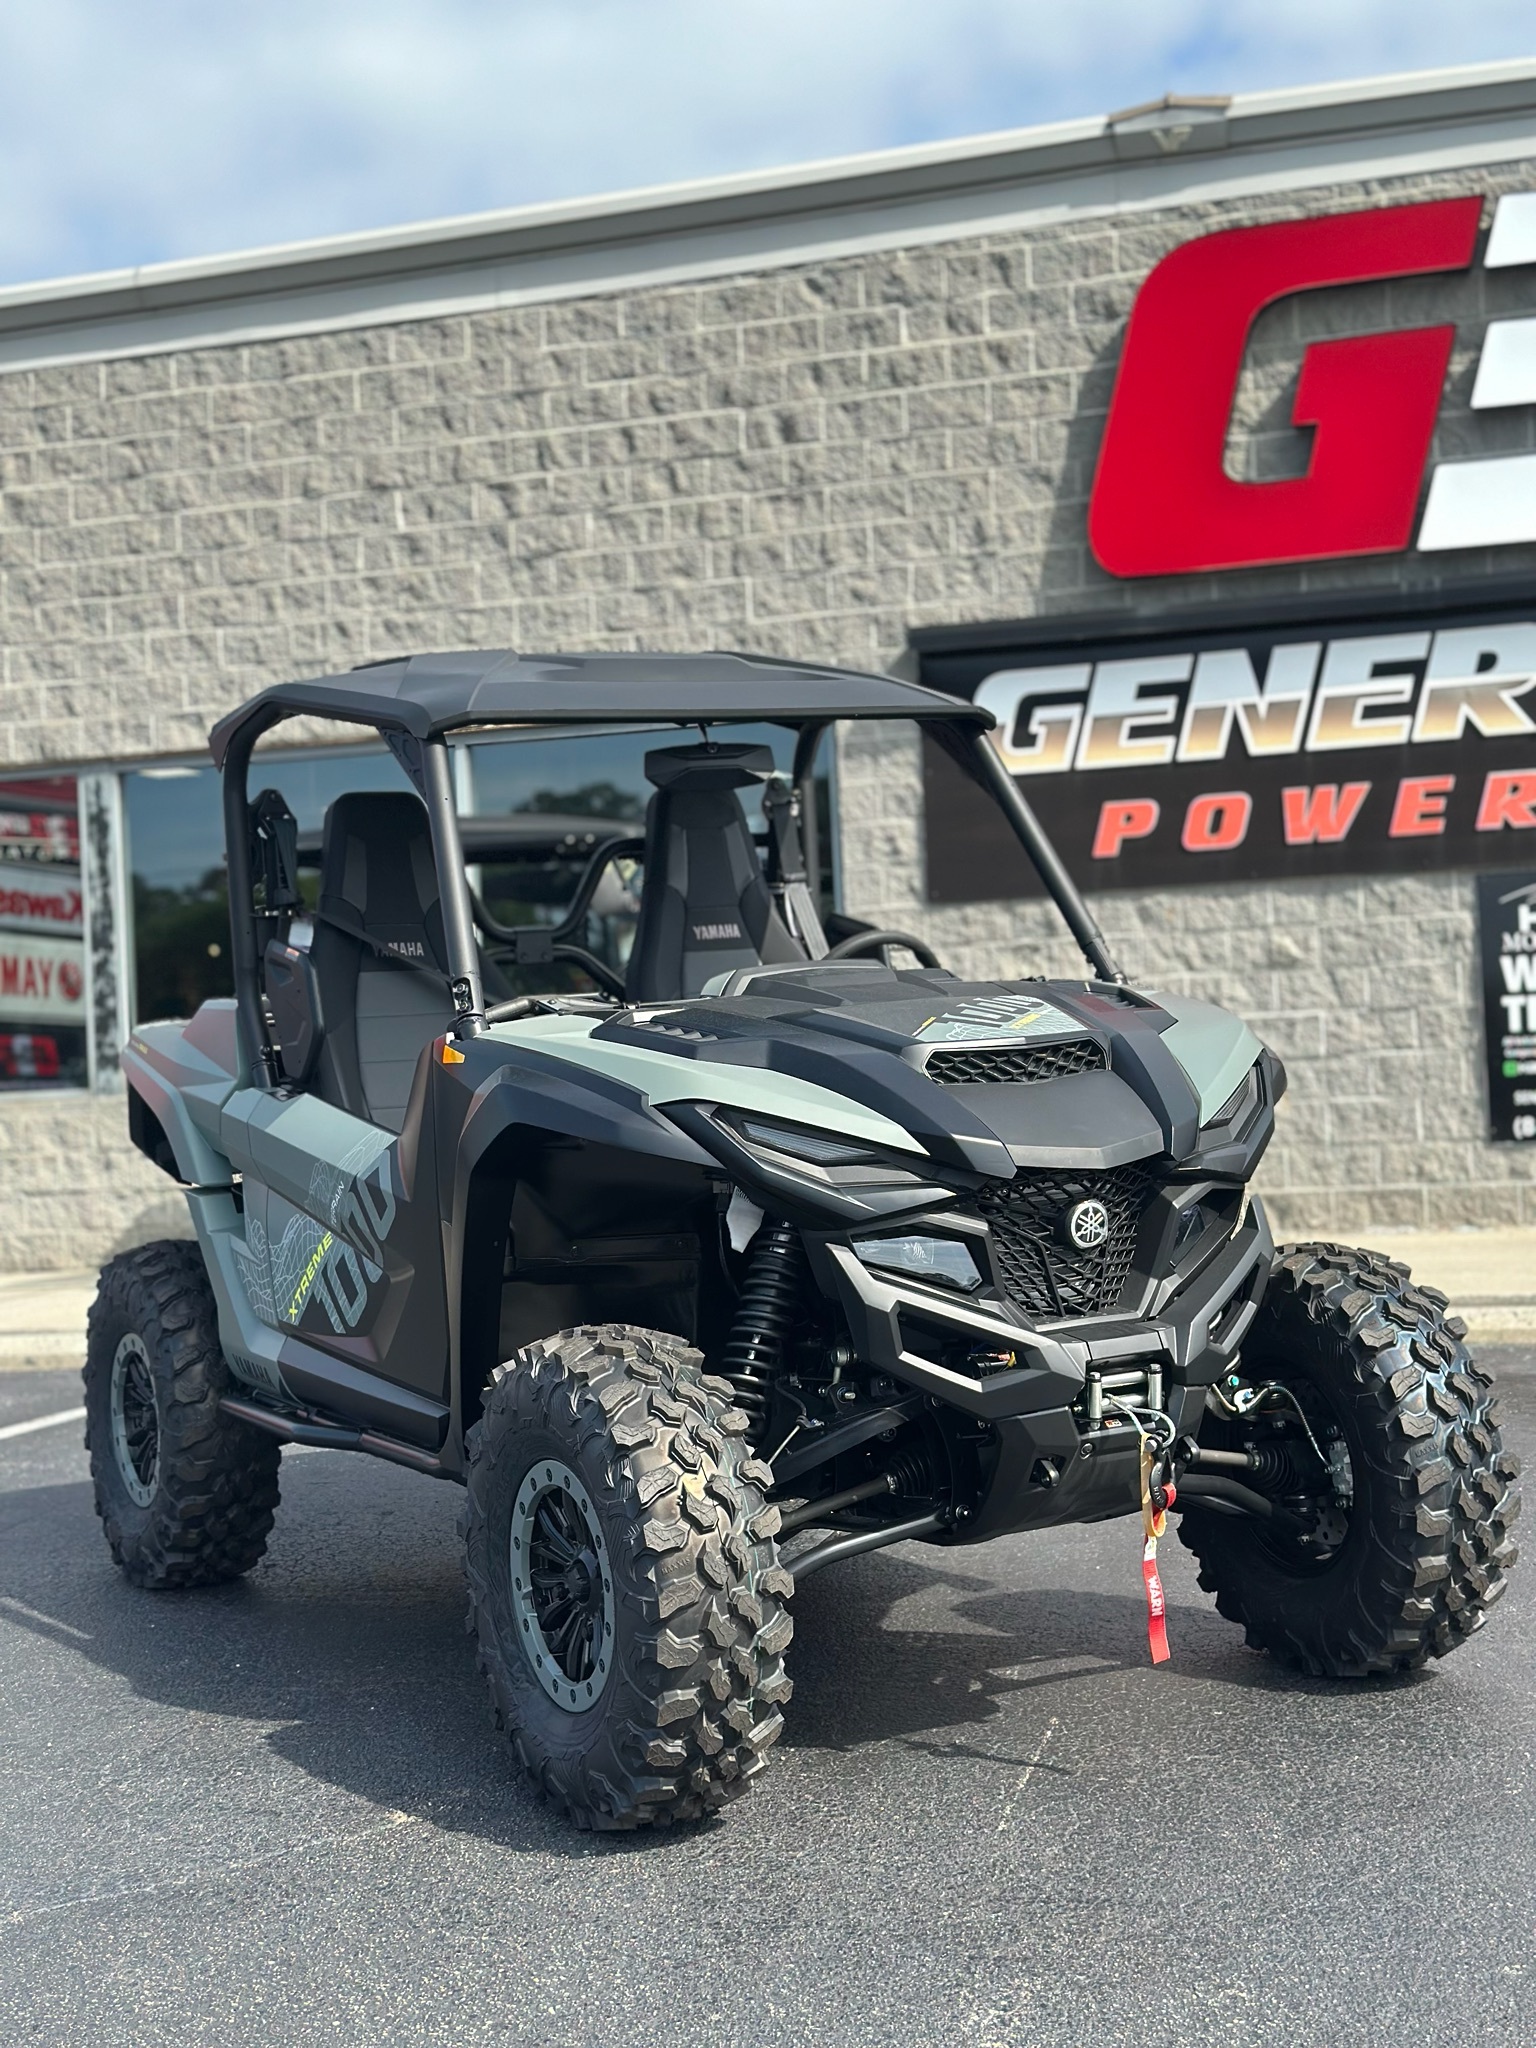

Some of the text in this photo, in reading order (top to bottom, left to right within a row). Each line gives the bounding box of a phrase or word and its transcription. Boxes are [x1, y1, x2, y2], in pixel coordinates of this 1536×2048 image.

[973, 622, 1536, 776] GENER
[1092, 768, 1536, 860] POWER
[692, 923, 742, 941] YAMAHA
[288, 1231, 334, 1323] XTREME
[231, 1352, 277, 1390] YAMAHA
[1147, 1574, 1164, 1617] WARN
